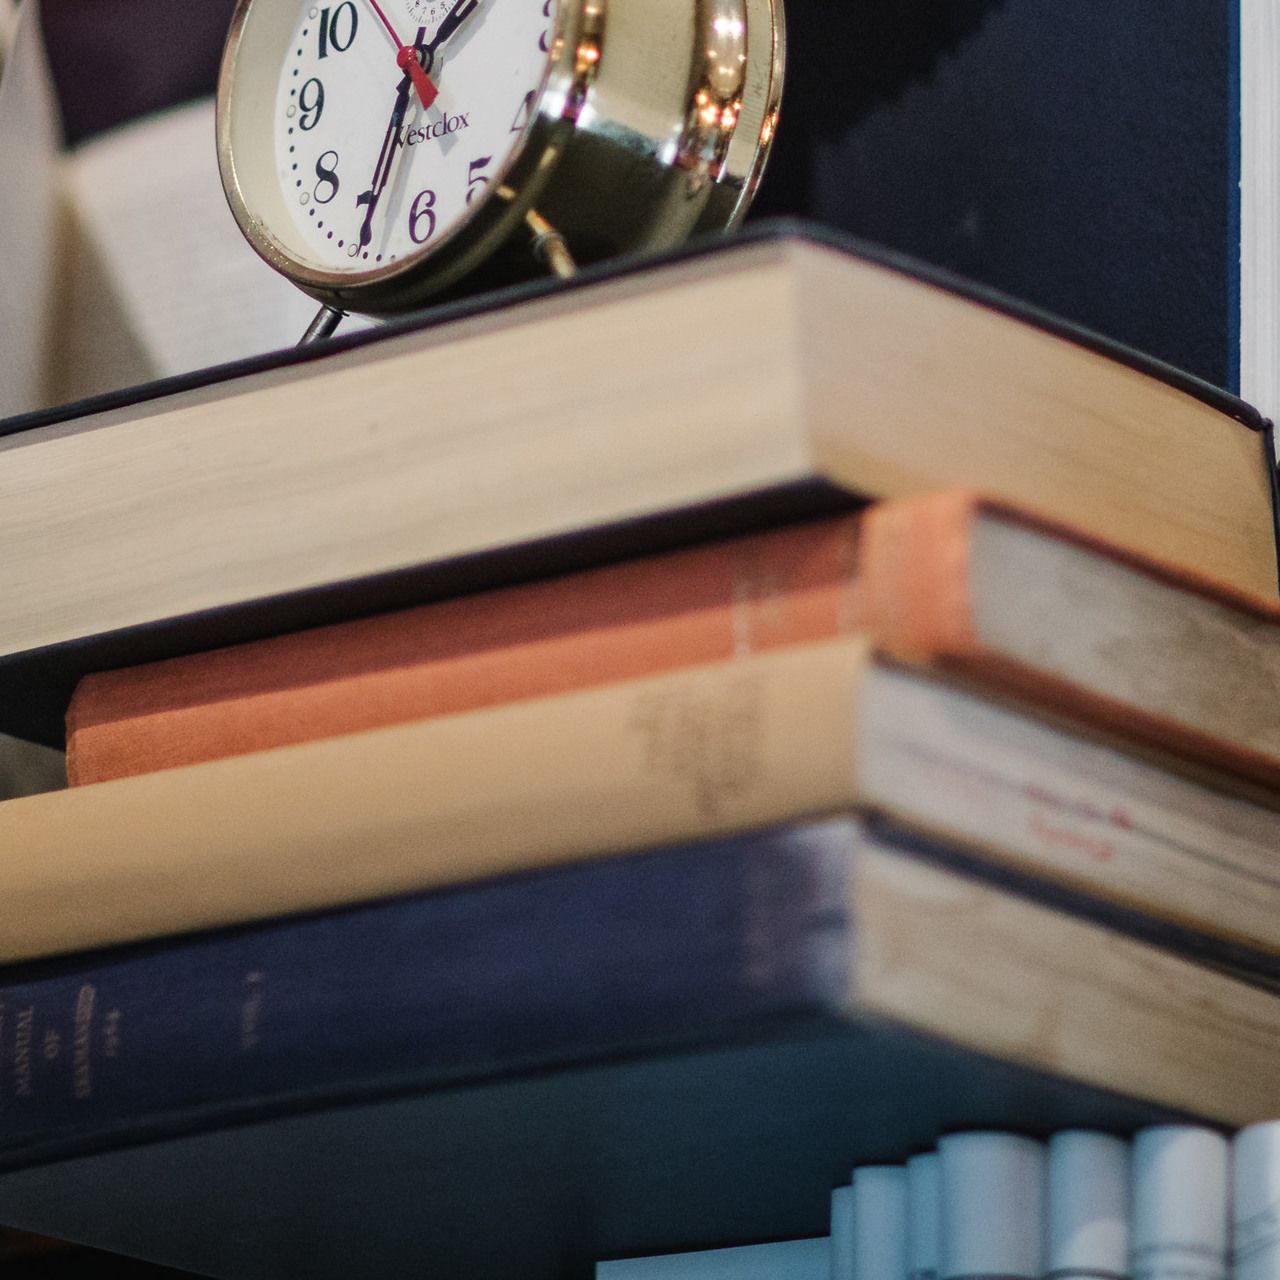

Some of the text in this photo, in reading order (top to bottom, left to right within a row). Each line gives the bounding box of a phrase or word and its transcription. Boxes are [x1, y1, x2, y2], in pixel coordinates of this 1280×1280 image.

[318, 1, 358, 60] 10
[298, 77, 325, 131] 9
[314, 150, 340, 204] 8
[408, 190, 437, 244] 6
[15, 1004, 34, 1097] MANUAL
[43, 1028, 60, 1060] OF
